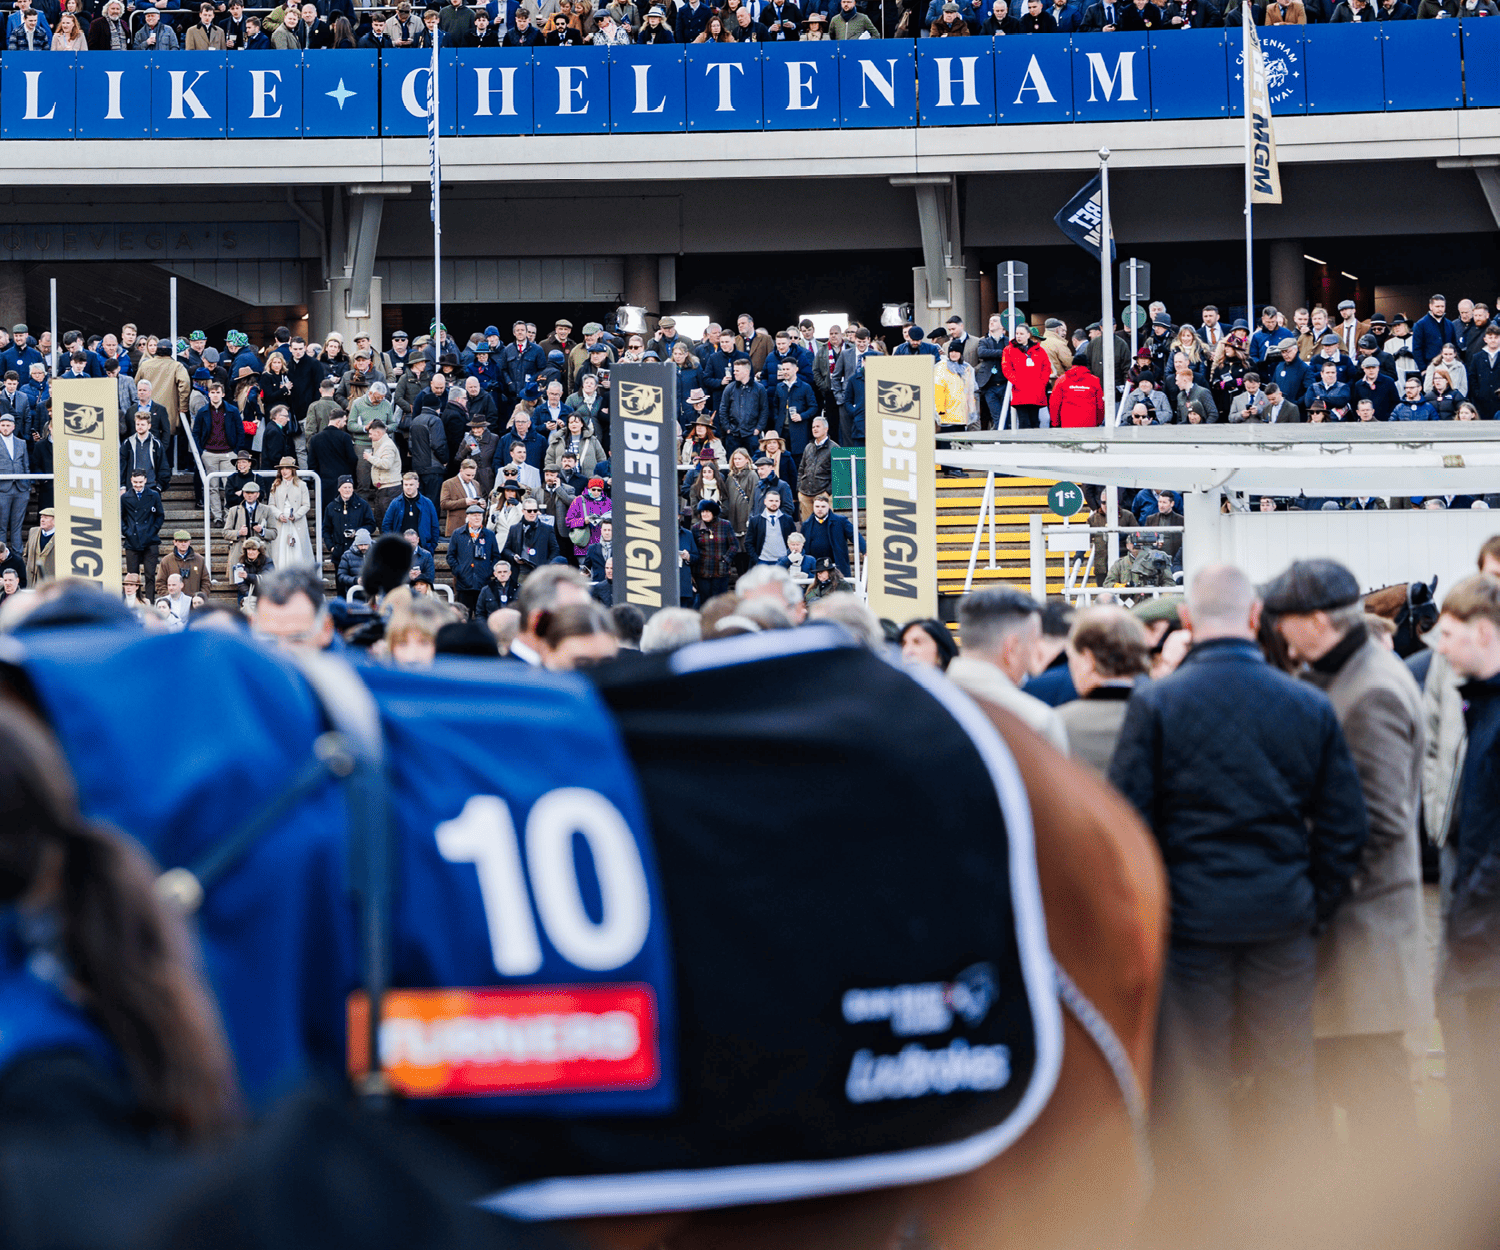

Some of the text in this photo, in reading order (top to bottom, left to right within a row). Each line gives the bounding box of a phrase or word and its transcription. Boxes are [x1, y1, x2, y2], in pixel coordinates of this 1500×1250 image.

[23, 70, 283, 120] LIKE
[401, 52, 1138, 118] CHELTENHAM
[1235, 38, 1298, 65] CHENHAM
[1251, 49, 1274, 196] BETMGM
[2, 230, 237, 251] QUEVEGA'S
[67, 439, 104, 590] BETMG
[623, 420, 662, 608] BETMGM
[881, 418, 919, 600] BETMGM
[1055, 490, 1076, 508] 1st
[434, 786, 651, 977] 10
